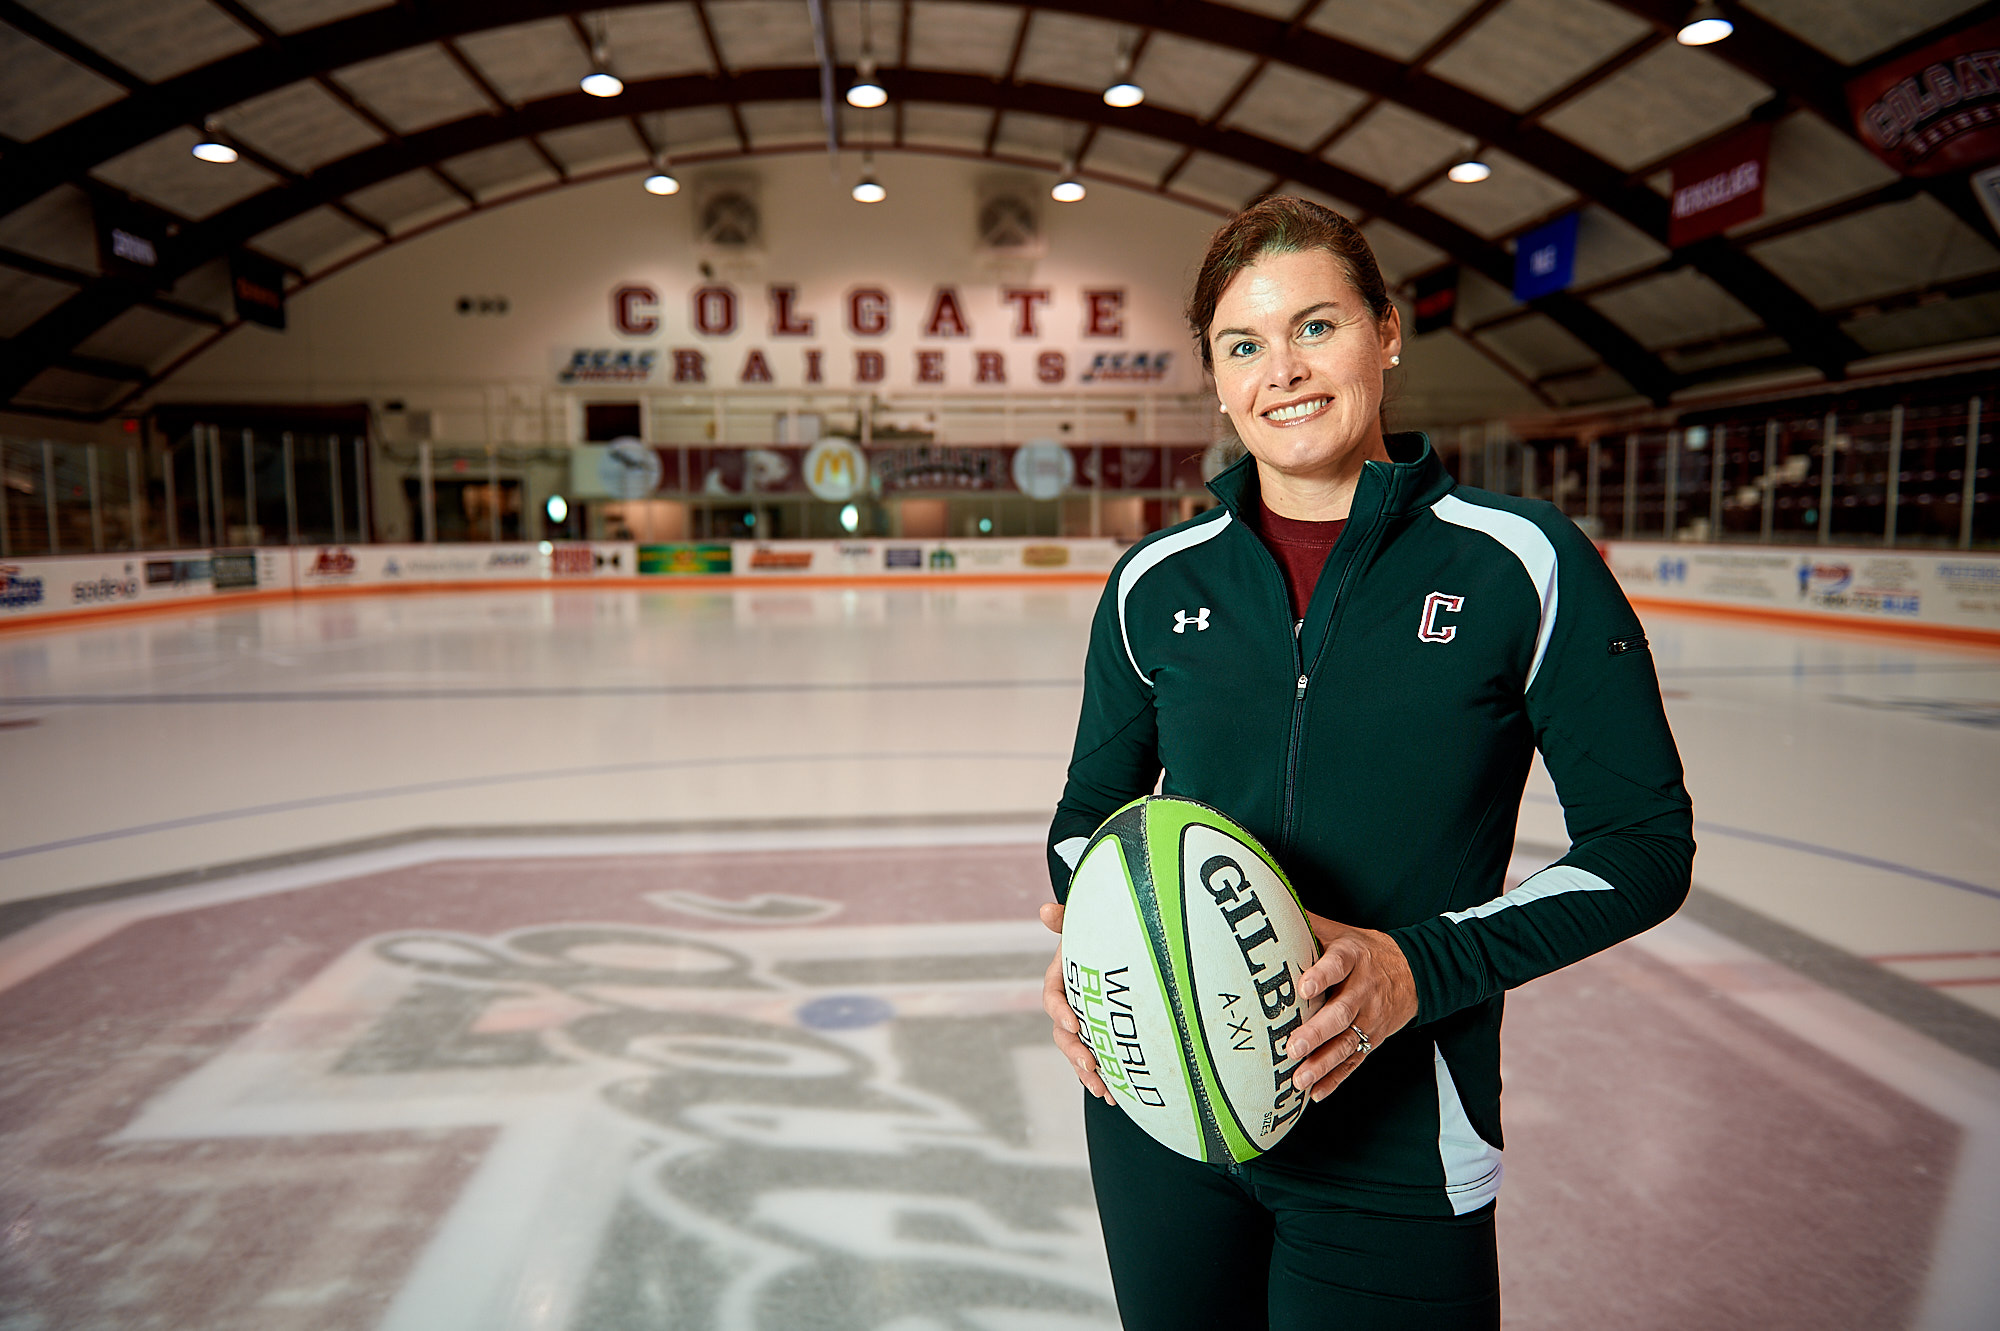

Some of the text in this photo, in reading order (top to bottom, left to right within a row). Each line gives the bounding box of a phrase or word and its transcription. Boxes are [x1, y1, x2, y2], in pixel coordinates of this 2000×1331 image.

[613, 285, 1126, 338] COLGATE
[672, 349, 1068, 385] RAIDERS
[1417, 591, 1465, 644] C
[1080, 963, 1138, 1103] RUGBY
[1104, 966, 1166, 1108] WORLD
[1217, 991, 1256, 1052] A-XV
